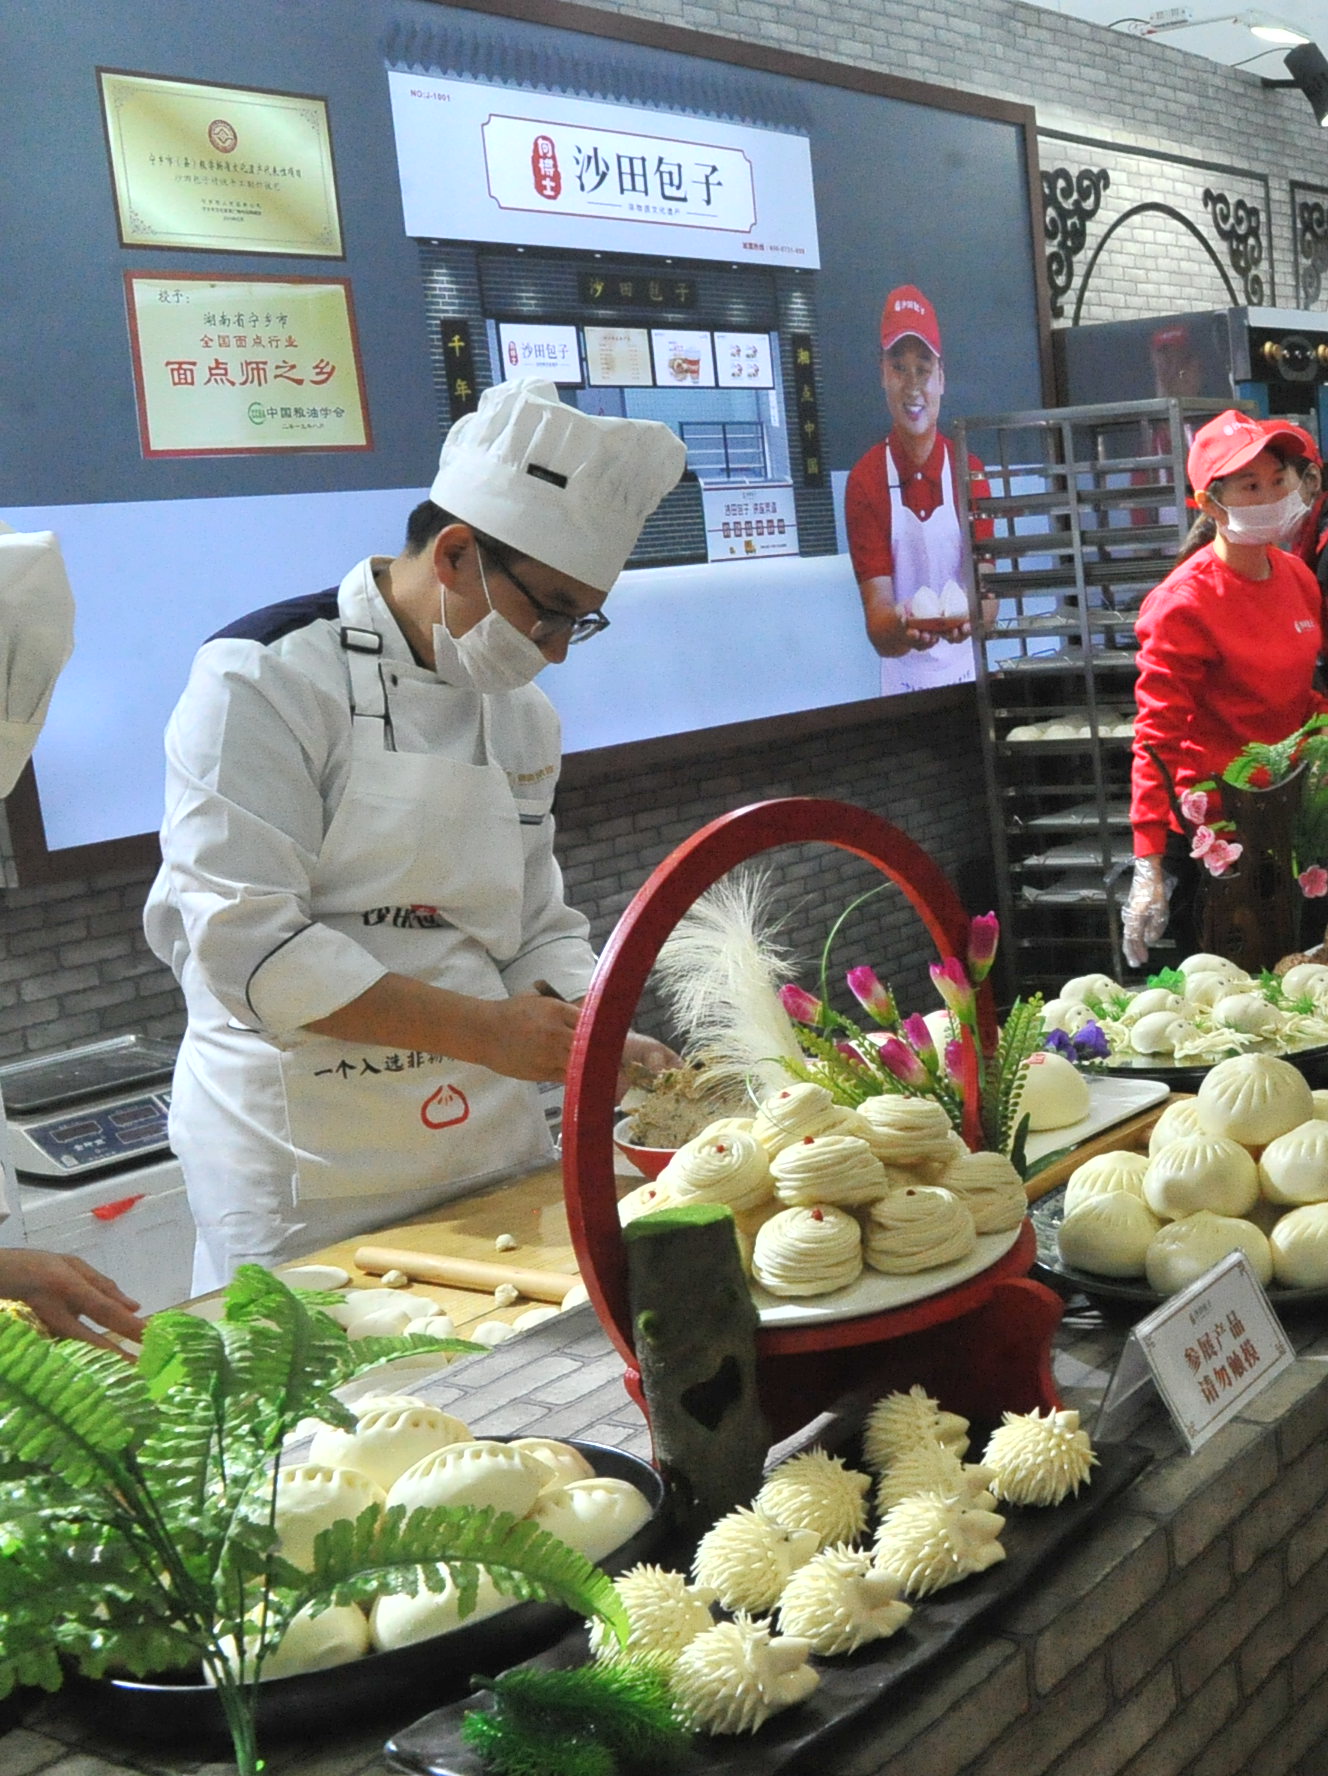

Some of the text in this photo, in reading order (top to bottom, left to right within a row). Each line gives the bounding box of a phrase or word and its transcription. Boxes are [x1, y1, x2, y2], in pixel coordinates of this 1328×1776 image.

[572, 144, 724, 206] 沙田包子
[589, 277, 690, 303] 沙田包子
[203, 311, 289, 329] 湖南省宁乡市
[199, 333, 299, 349] 全国面点行业
[520, 342, 570, 361] 沙田包子
[164, 357, 337, 388] 面点师之乡
[266, 406, 346, 420] 中国粮油学会
[1183, 1309, 1246, 1377] 参展产品
